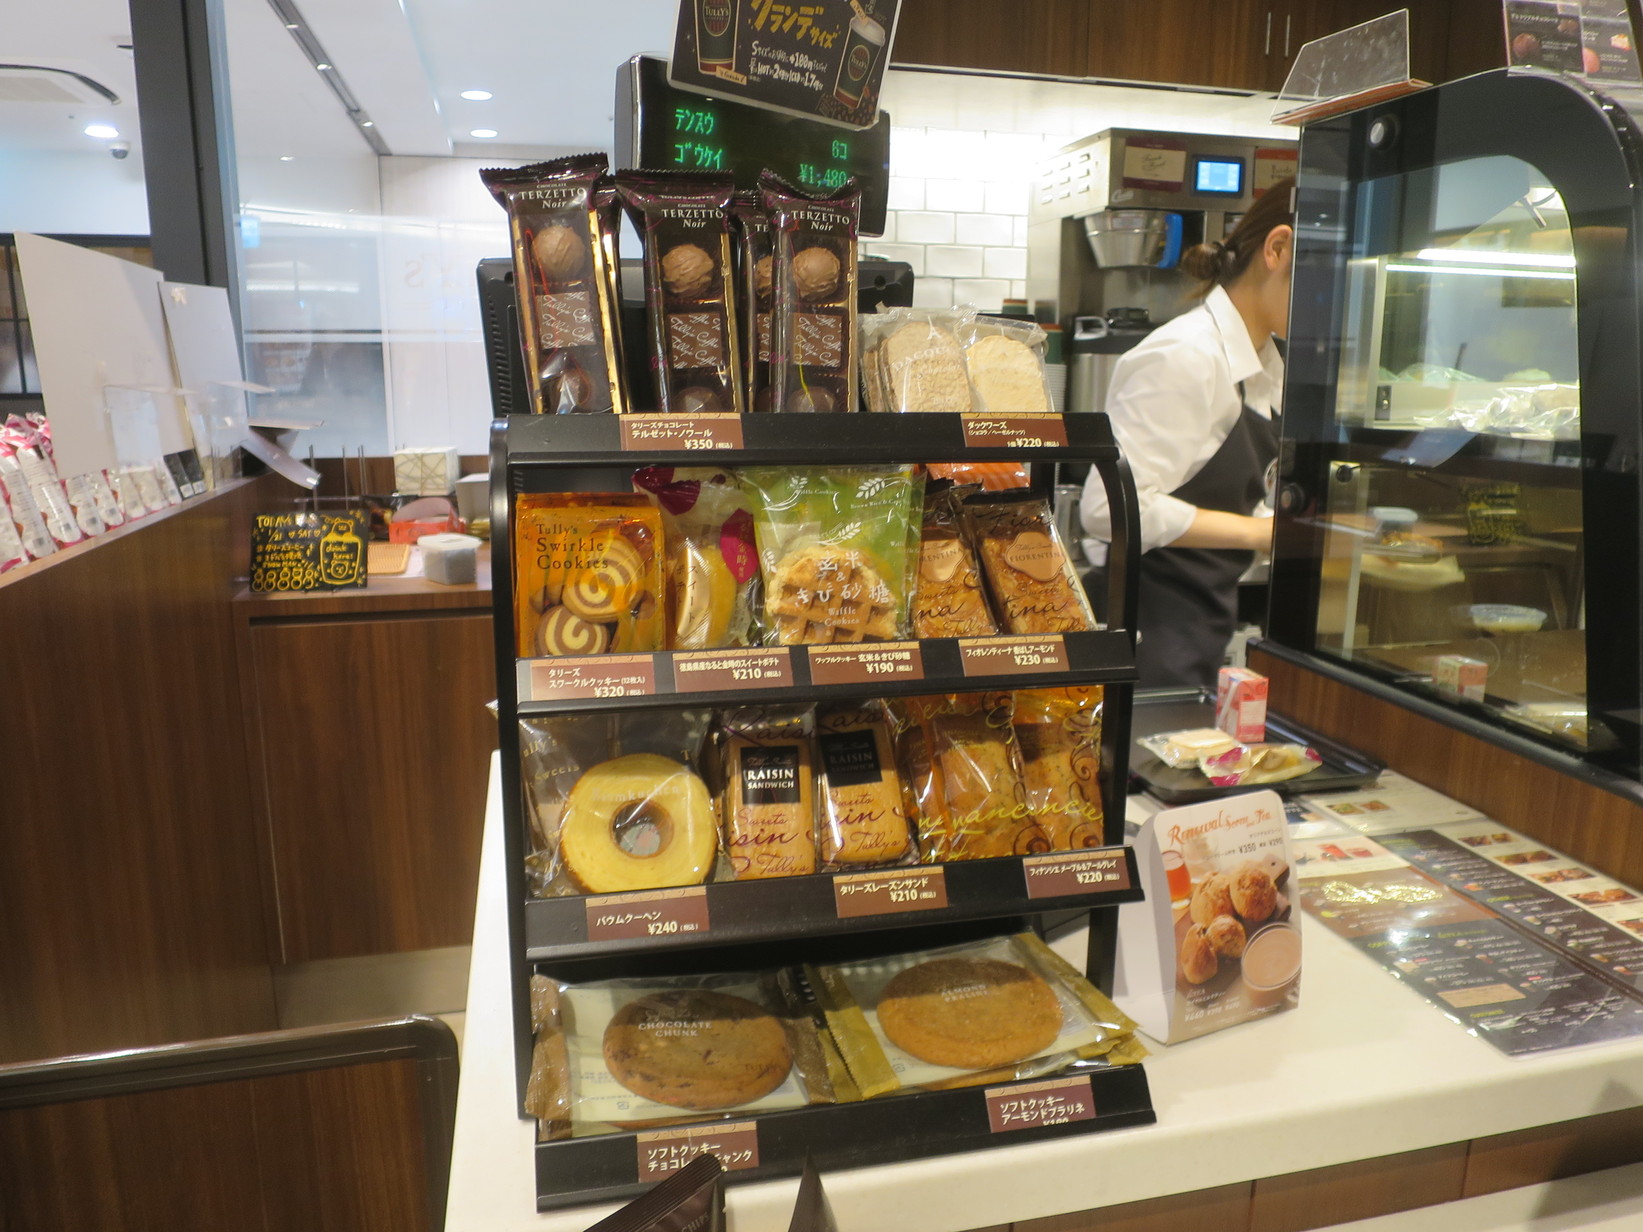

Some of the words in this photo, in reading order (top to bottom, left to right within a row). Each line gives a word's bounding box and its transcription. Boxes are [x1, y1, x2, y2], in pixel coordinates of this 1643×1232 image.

[705, 6, 729, 17] TULLY'S
[810, 27, 838, 48] サイズ
[675, 108, 714, 135] テンスウ
[674, 142, 724, 170] ゴウケイ
[832, 140, 848, 160] 6コ
[800, 164, 847, 189] ¥1,480
[519, 188, 587, 201] TERZETTO
[543, 200, 566, 209] Noir
[662, 208, 724, 220] TERZETTO
[792, 210, 850, 225] TERZETTO
[683, 219, 707, 228] Noir
[811, 221, 834, 231] Noir
[544, 295, 570, 315] Tully's
[543, 314, 570, 334] Tully's
[671, 317, 696, 338] Tully's
[697, 331, 719, 348] Coffee
[797, 316, 821, 338] Tully's
[822, 335, 842, 352] Coffee
[672, 336, 694, 356] Tully's
[695, 350, 718, 366] Coffee
[631, 421, 694, 430] タリーズチョコレート
[968, 421, 1007, 430] ダックワーズ
[632, 429, 713, 440] テルゼット・ノワール
[684, 438, 713, 450] ¥350
[536, 523, 578, 539] Tully's
[536, 537, 605, 552] Swirkle
[536, 555, 610, 570] Cookies
[836, 571, 847, 582] &
[795, 580, 890, 608] きび砂糖
[828, 606, 857, 616] Waffle
[824, 616, 861, 627] Cookies
[966, 646, 1012, 658] フィオレンティーナ
[1014, 653, 1041, 666] ¥230
[815, 656, 857, 665] ワッフルクッキー
[866, 662, 894, 674] ¥190
[548, 667, 581, 679] タリーズ
[732, 668, 761, 681] ¥210
[548, 676, 621, 690] スワークルクッキー
[594, 685, 625, 698] ¥320
[523, 736, 558, 758] ully's
[830, 752, 873, 766] RAISIN
[747, 768, 795, 782] RAISIN
[747, 780, 795, 792] SANDWICH
[734, 807, 788, 827] Sweets
[727, 828, 800, 847] isin
[850, 830, 902, 857] Tully's
[756, 853, 810, 877] Tully's
[1076, 870, 1103, 885] ¥220
[840, 877, 930, 896] タリーズレーズンサンド
[890, 889, 919, 903] ¥210
[596, 911, 662, 927] バウムクーヘン
[648, 920, 678, 936] ¥240
[638, 1020, 713, 1031] CHOCOLATE
[655, 1030, 699, 1039] CHUNK
[1000, 1096, 1065, 1114] ソフトクッキー
[1001, 1102, 1085, 1127] アーモンドプラリネ
[647, 1142, 722, 1161] ソフトクッキー
[647, 1149, 753, 1174] チョコレャンク
